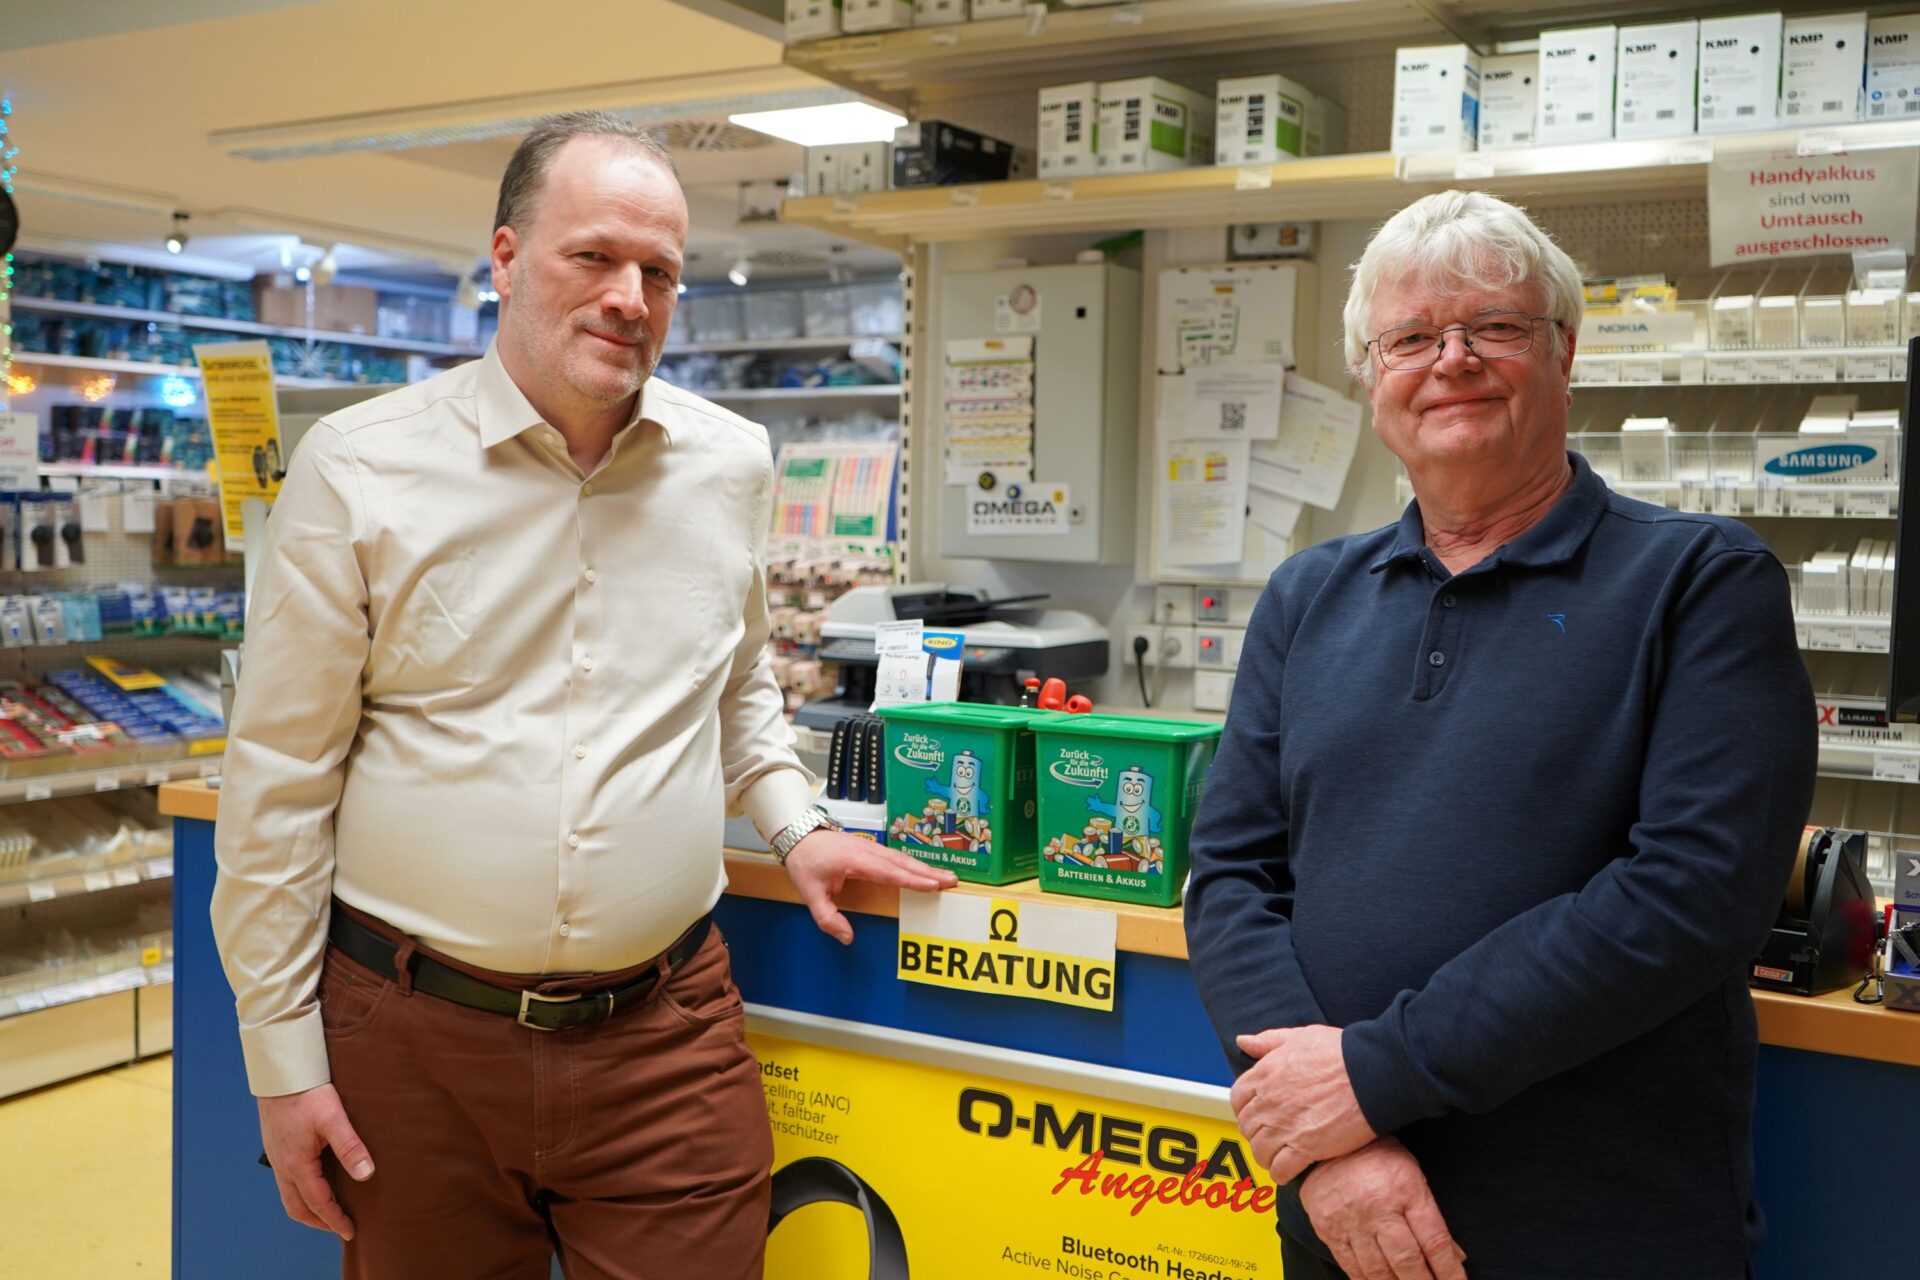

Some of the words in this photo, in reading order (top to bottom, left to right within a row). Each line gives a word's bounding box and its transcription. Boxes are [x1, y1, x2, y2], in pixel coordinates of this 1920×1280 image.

[1705, 38, 1738, 49] KMP
[1789, 33, 1823, 45] KMP
[1873, 33, 1908, 46] KMP
[1749, 165, 1876, 187] Handyakkus
[1769, 191, 1805, 208] sind
[1811, 192, 1850, 205] vom
[1761, 210, 1863, 230] Umtausch
[1735, 233, 1889, 257] ausgeschlossen
[1598, 323, 1648, 334] NOKIA
[1779, 453, 1862, 468] SAMSUNG
[974, 501, 1056, 515] OMEGA
[904, 732, 928, 744] Zurück
[1851, 728, 1902, 741] FUJIFILM
[907, 747, 944, 762] Zukunft!
[1060, 748, 1089, 760] Zurück
[1064, 764, 1108, 779] Zukunft!
[942, 852, 948, 862] &
[1106, 874, 1113, 884] &
[900, 940, 1112, 1000] BERATUNG
[810, 1091, 851, 1115] (ANC)
[783, 1103, 826, 1124] faltbar
[1051, 1149, 1277, 1217] Angebote
[1062, 1236, 1159, 1274] Bluetooth
[1002, 1246, 1051, 1270] Active
[1056, 1258, 1103, 1280] Noise
